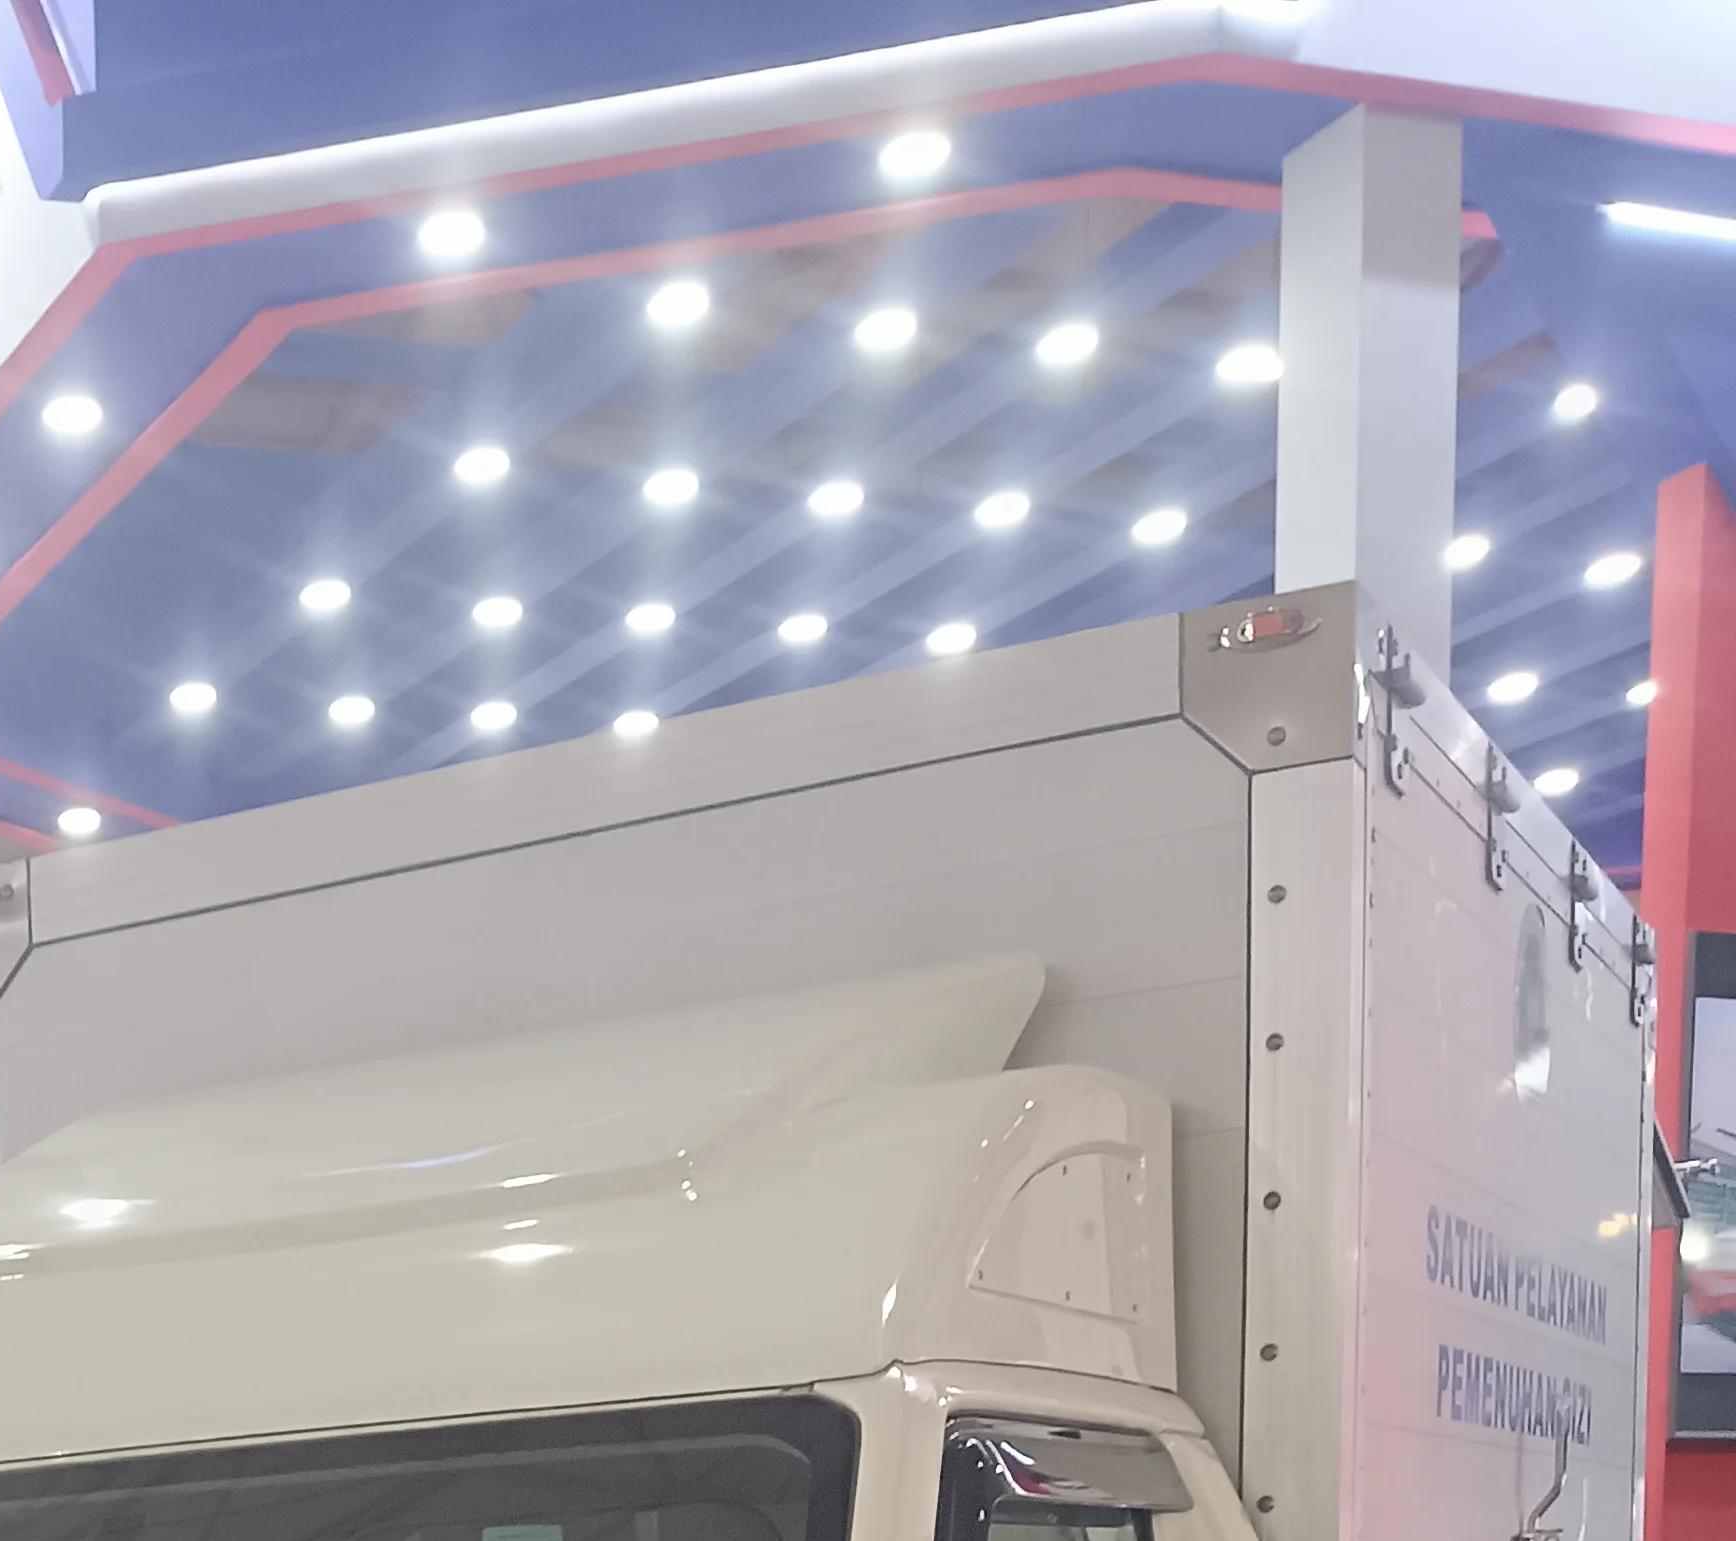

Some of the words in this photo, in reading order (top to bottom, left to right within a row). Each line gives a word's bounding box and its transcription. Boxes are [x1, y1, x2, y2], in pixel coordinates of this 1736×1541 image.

[1426, 1204, 1510, 1308] SATUAN
[1514, 1258, 1607, 1346] PELAYANAN
[1436, 1343, 1556, 1440] PEMENUHAN
